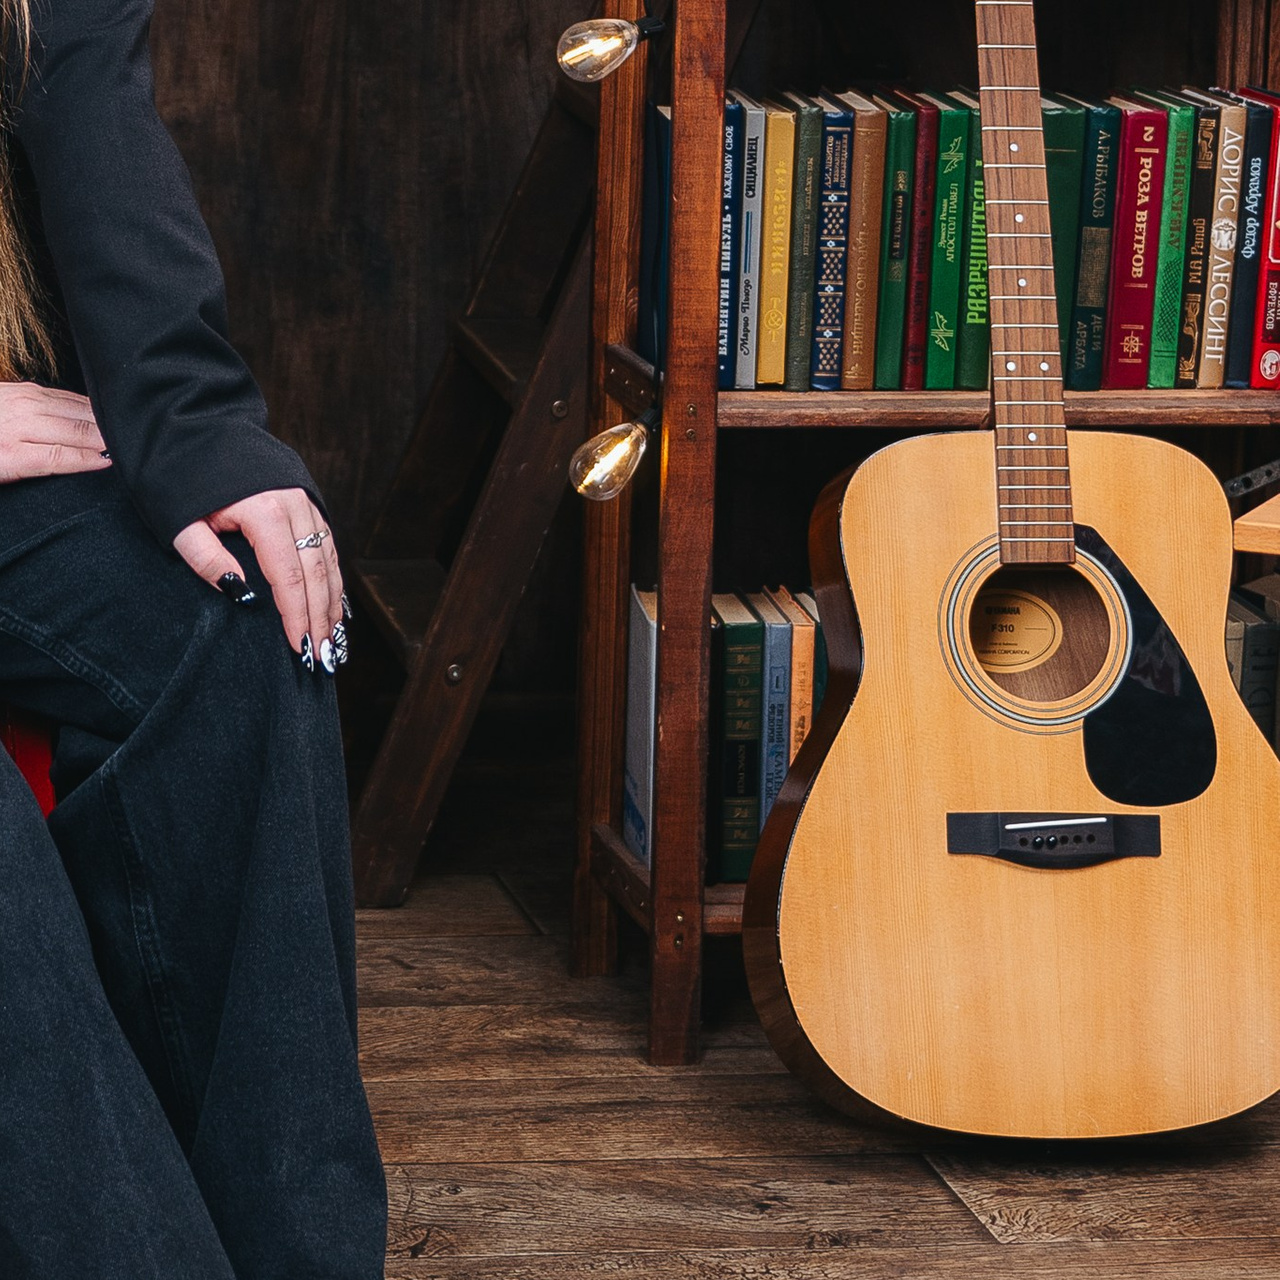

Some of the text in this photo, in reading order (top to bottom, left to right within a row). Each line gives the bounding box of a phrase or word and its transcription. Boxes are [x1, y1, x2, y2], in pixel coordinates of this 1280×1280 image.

[745, 136, 759, 199] СИЦИЛИЕЦ
[1143, 126, 1155, 142] 2
[1092, 129, 1111, 218] А.РЫБАКОВ
[1241, 157, 1262, 259] Федор Абрамов
[718, 125, 734, 356] ВАЛЕНТИН ПИКУЛЬ КАЖДОМУ СВОЕ
[946, 183, 958, 262] АПОСТОЛ ПАВЕЛ
[1131, 157, 1153, 278] РОЗА ВЕТРОВ
[1192, 218, 1206, 256] Рапов
[1205, 127, 1243, 365] ДОРИС ЛЕССИНГ
[740, 278, 751, 356] Марио Пьюзо
[853, 230, 868, 355] ЦАРСТВО ЖЕНЩИН
[1265, 282, 1278, 330] ЕФРЕМОВ
[1074, 321, 1087, 369] АРБАТА
[1091, 314, 1102, 351] ДЕТИ
[768, 704, 776, 743] ФЕДОРОВ
[775, 704, 784, 742] ЕВГЕНИЙ
